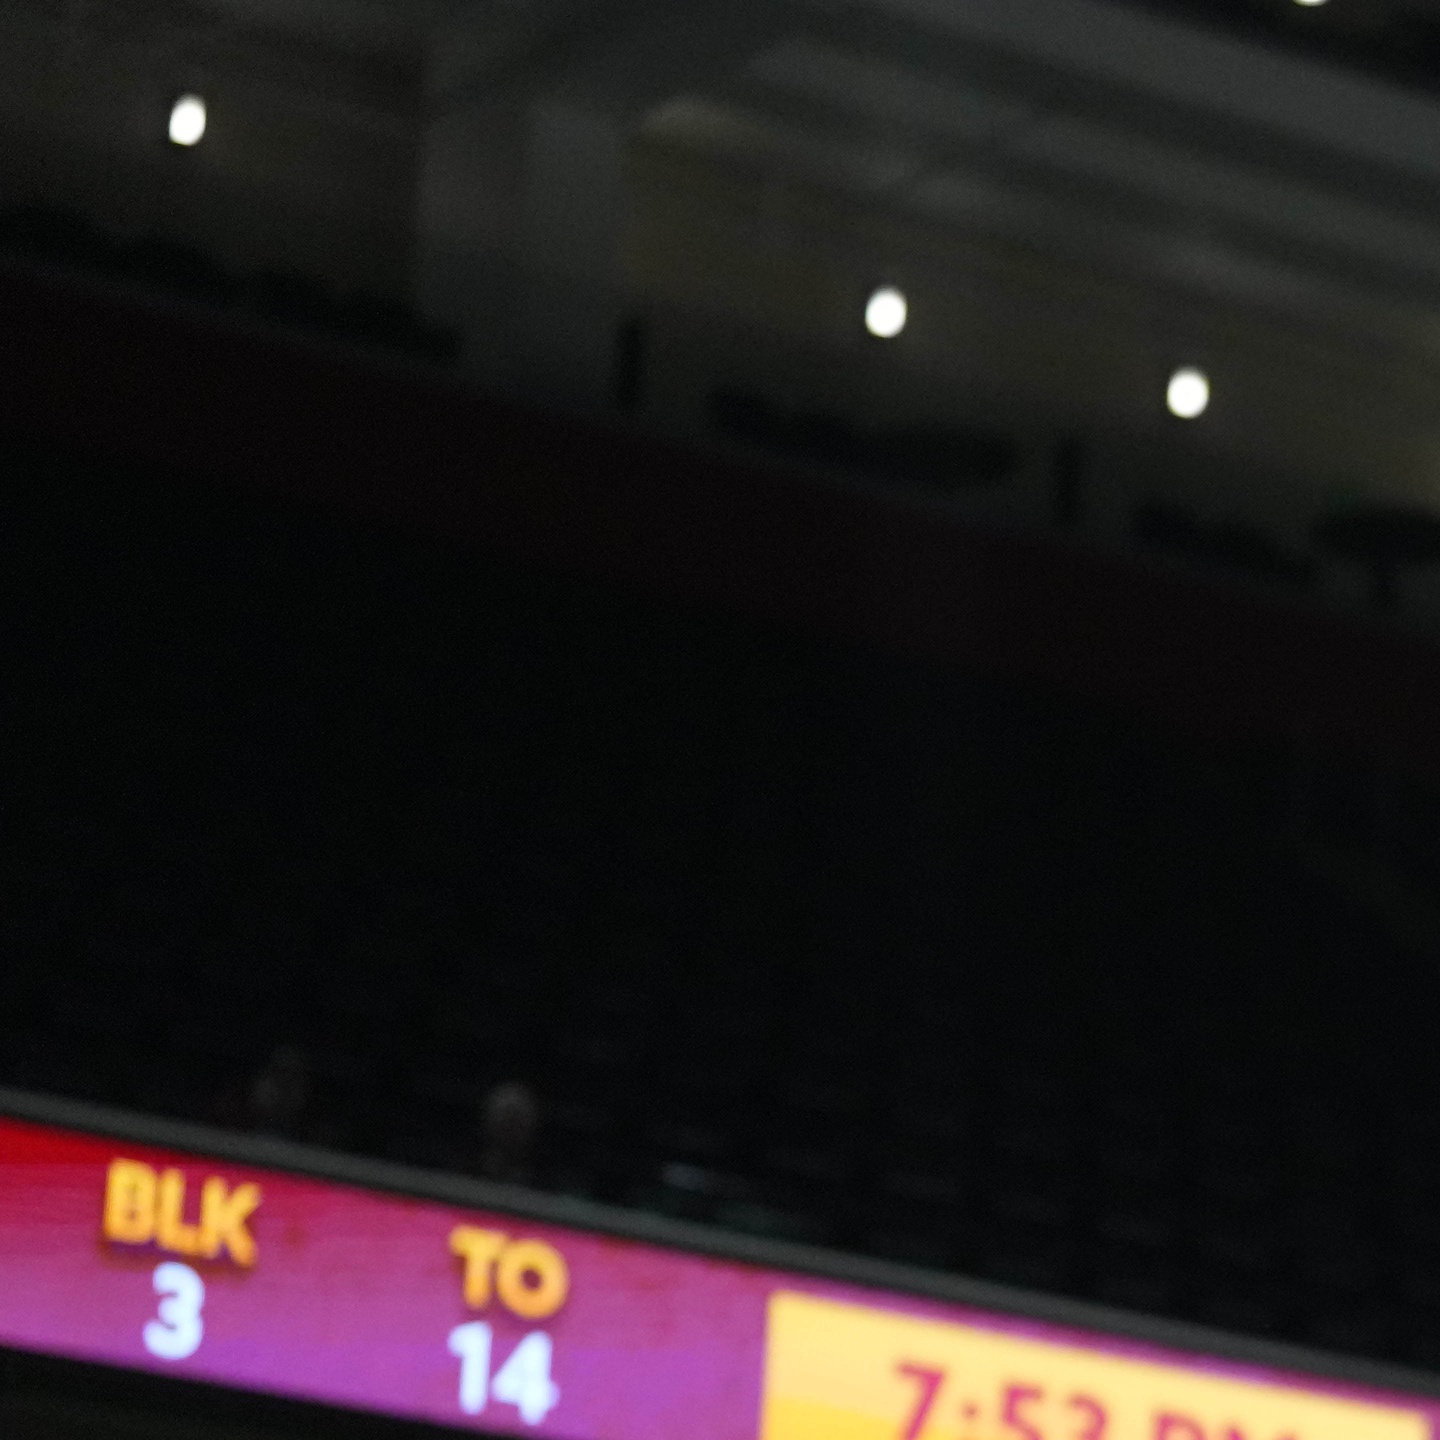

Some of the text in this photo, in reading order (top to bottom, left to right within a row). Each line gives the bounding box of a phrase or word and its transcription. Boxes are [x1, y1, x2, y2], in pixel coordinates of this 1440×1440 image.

[103, 1157, 568, 1319] BLK TO
[143, 1261, 560, 1424] 3 14
